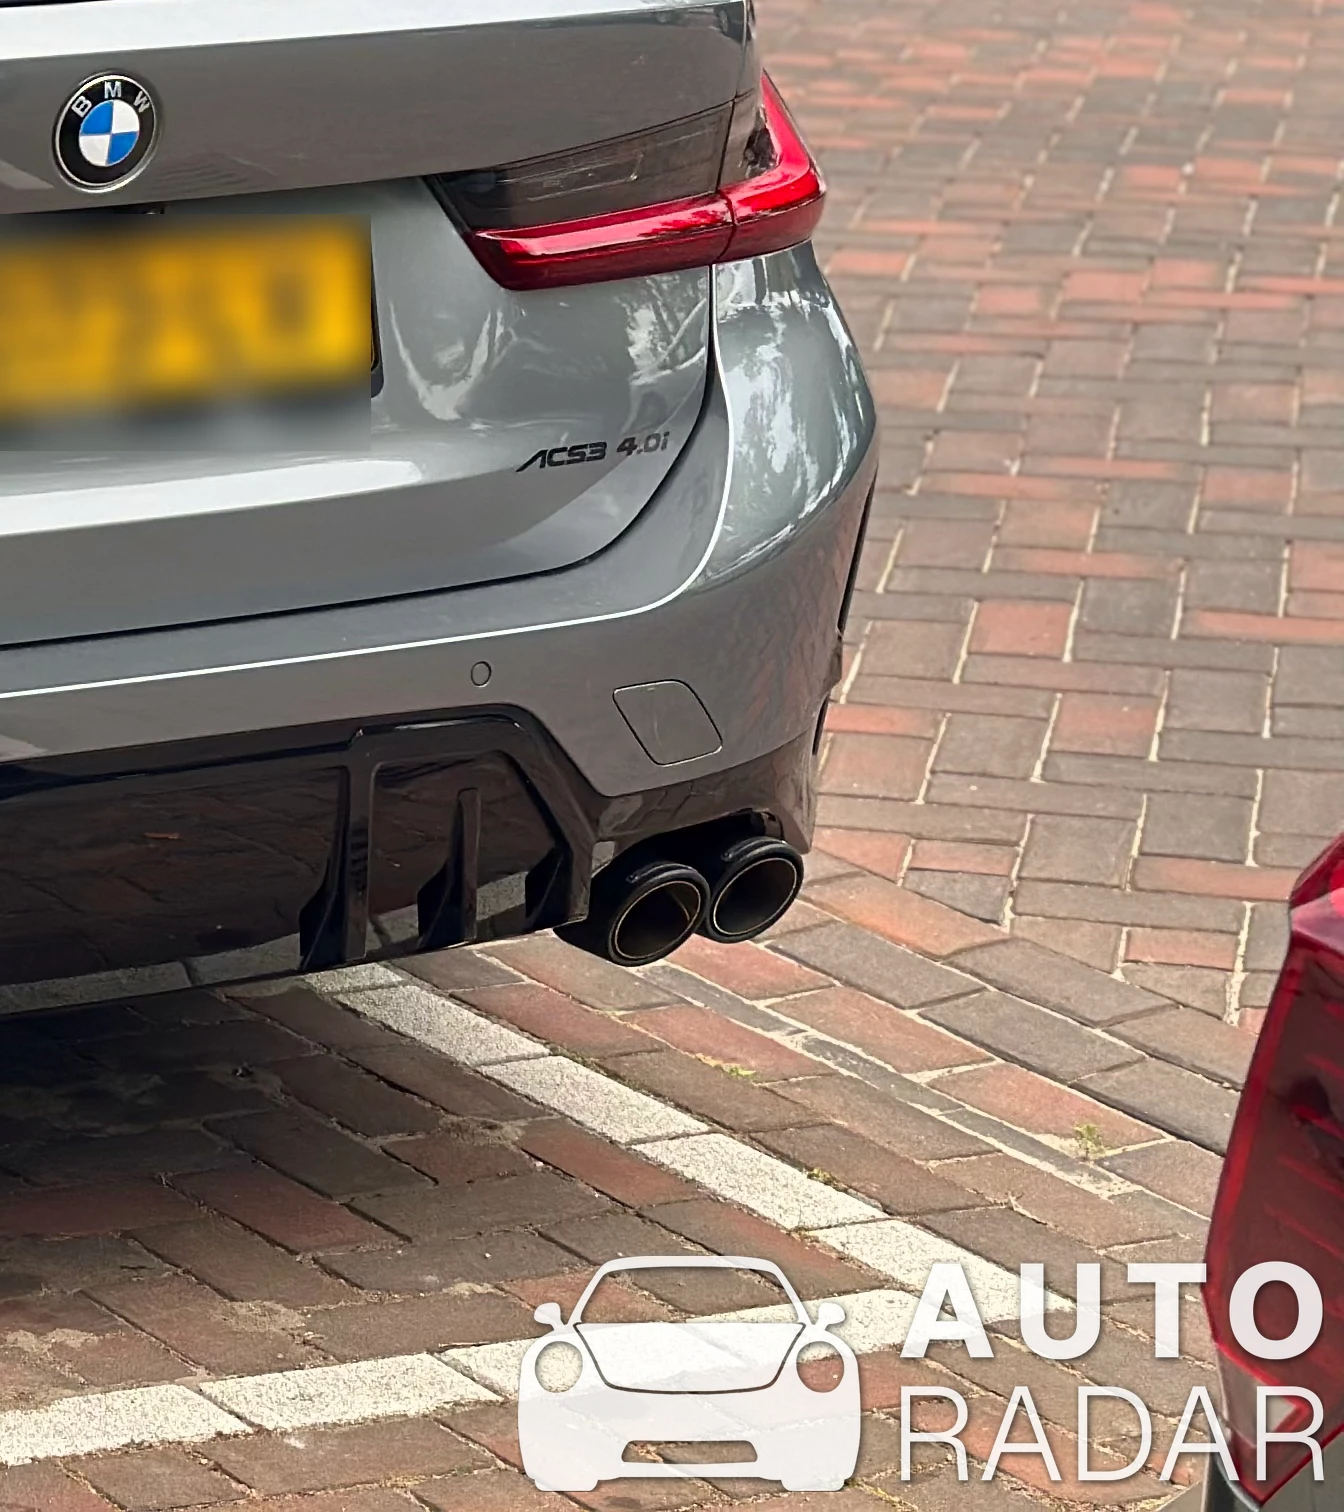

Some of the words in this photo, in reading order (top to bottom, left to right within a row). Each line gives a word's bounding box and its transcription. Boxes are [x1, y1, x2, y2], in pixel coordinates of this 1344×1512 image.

[71, 80, 150, 118] BMW
[515, 441, 608, 473] ACS3
[616, 432, 670, 457] 4.0i
